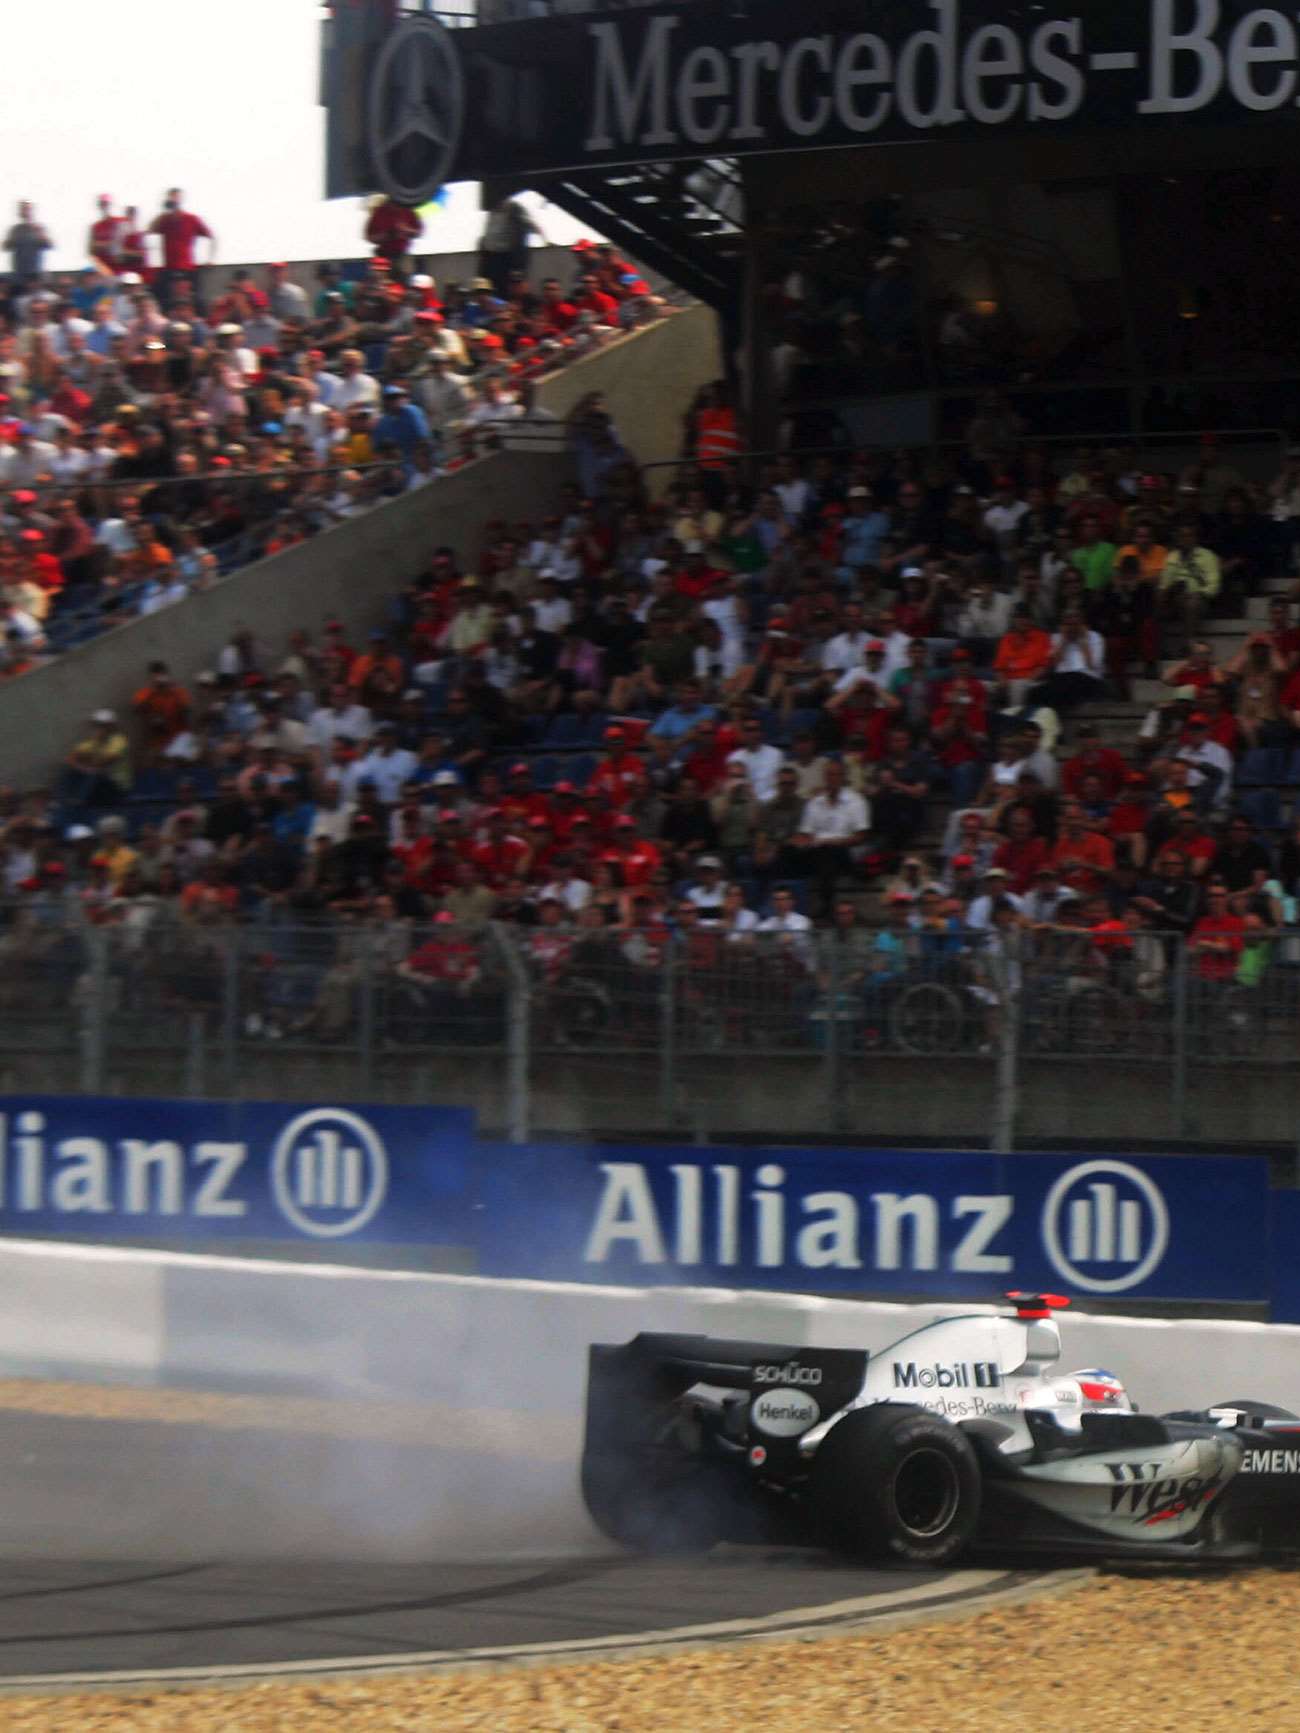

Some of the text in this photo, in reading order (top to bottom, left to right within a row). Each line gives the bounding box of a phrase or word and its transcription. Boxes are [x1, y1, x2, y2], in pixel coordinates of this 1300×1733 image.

[0, 1111, 248, 1216] ianz
[585, 1163, 1014, 1273] Allianz
[893, 1362, 969, 1388] Mobil
[760, 1402, 813, 1420] Henkel
